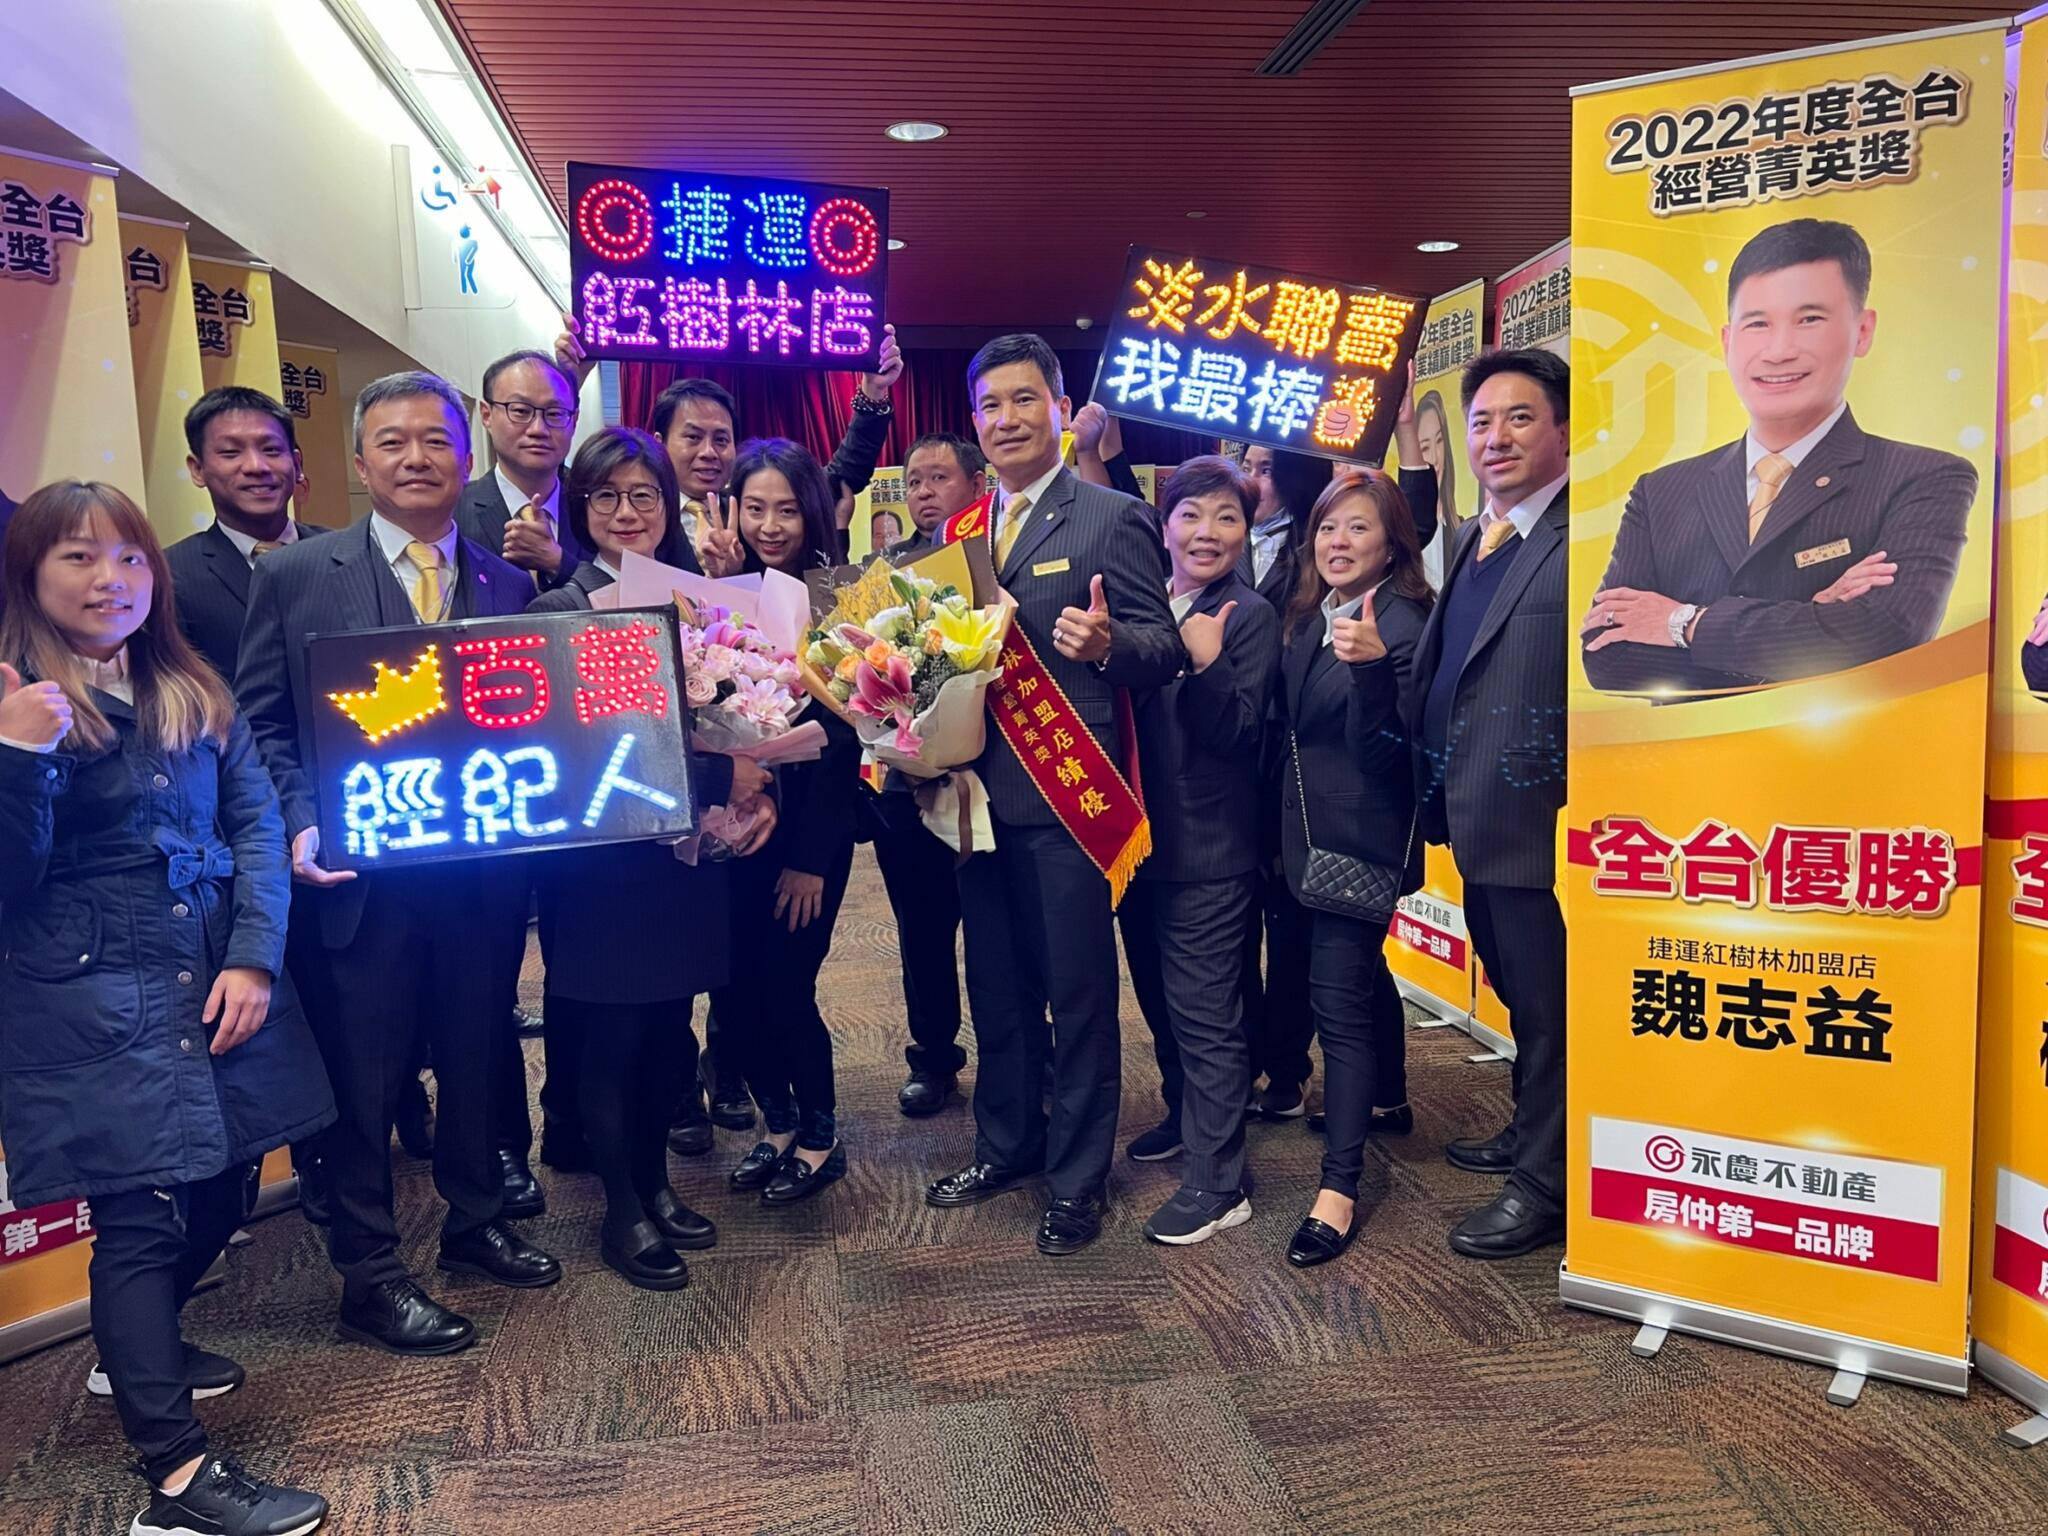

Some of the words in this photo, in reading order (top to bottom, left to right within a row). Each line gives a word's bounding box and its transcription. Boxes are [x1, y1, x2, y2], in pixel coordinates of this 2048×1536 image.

[1610, 72, 1962, 165] 2022年度全台
[1653, 129, 1911, 210] 經營菁英獎
[0, 184, 85, 238] 全台
[661, 182, 807, 267] 捷運
[0, 231, 51, 276] 獎
[127, 247, 161, 285] 台
[192, 281, 249, 320] 全台
[582, 271, 875, 354] 紅樹林店
[1127, 258, 1416, 371] 淡水聯賣
[281, 362, 322, 390] 全台
[1105, 337, 1325, 438] 我最棒
[451, 618, 669, 730] 百萬
[343, 733, 678, 857] 經紀人
[1596, 820, 1952, 912] 全台優勝
[1647, 936, 1877, 980] 捷運紅樹林加盟店
[1631, 968, 1894, 1064] 魏志益
[1690, 1147, 1877, 1203] 永慶不動產
[1644, 1187, 1875, 1262] 房仲第一品牌
